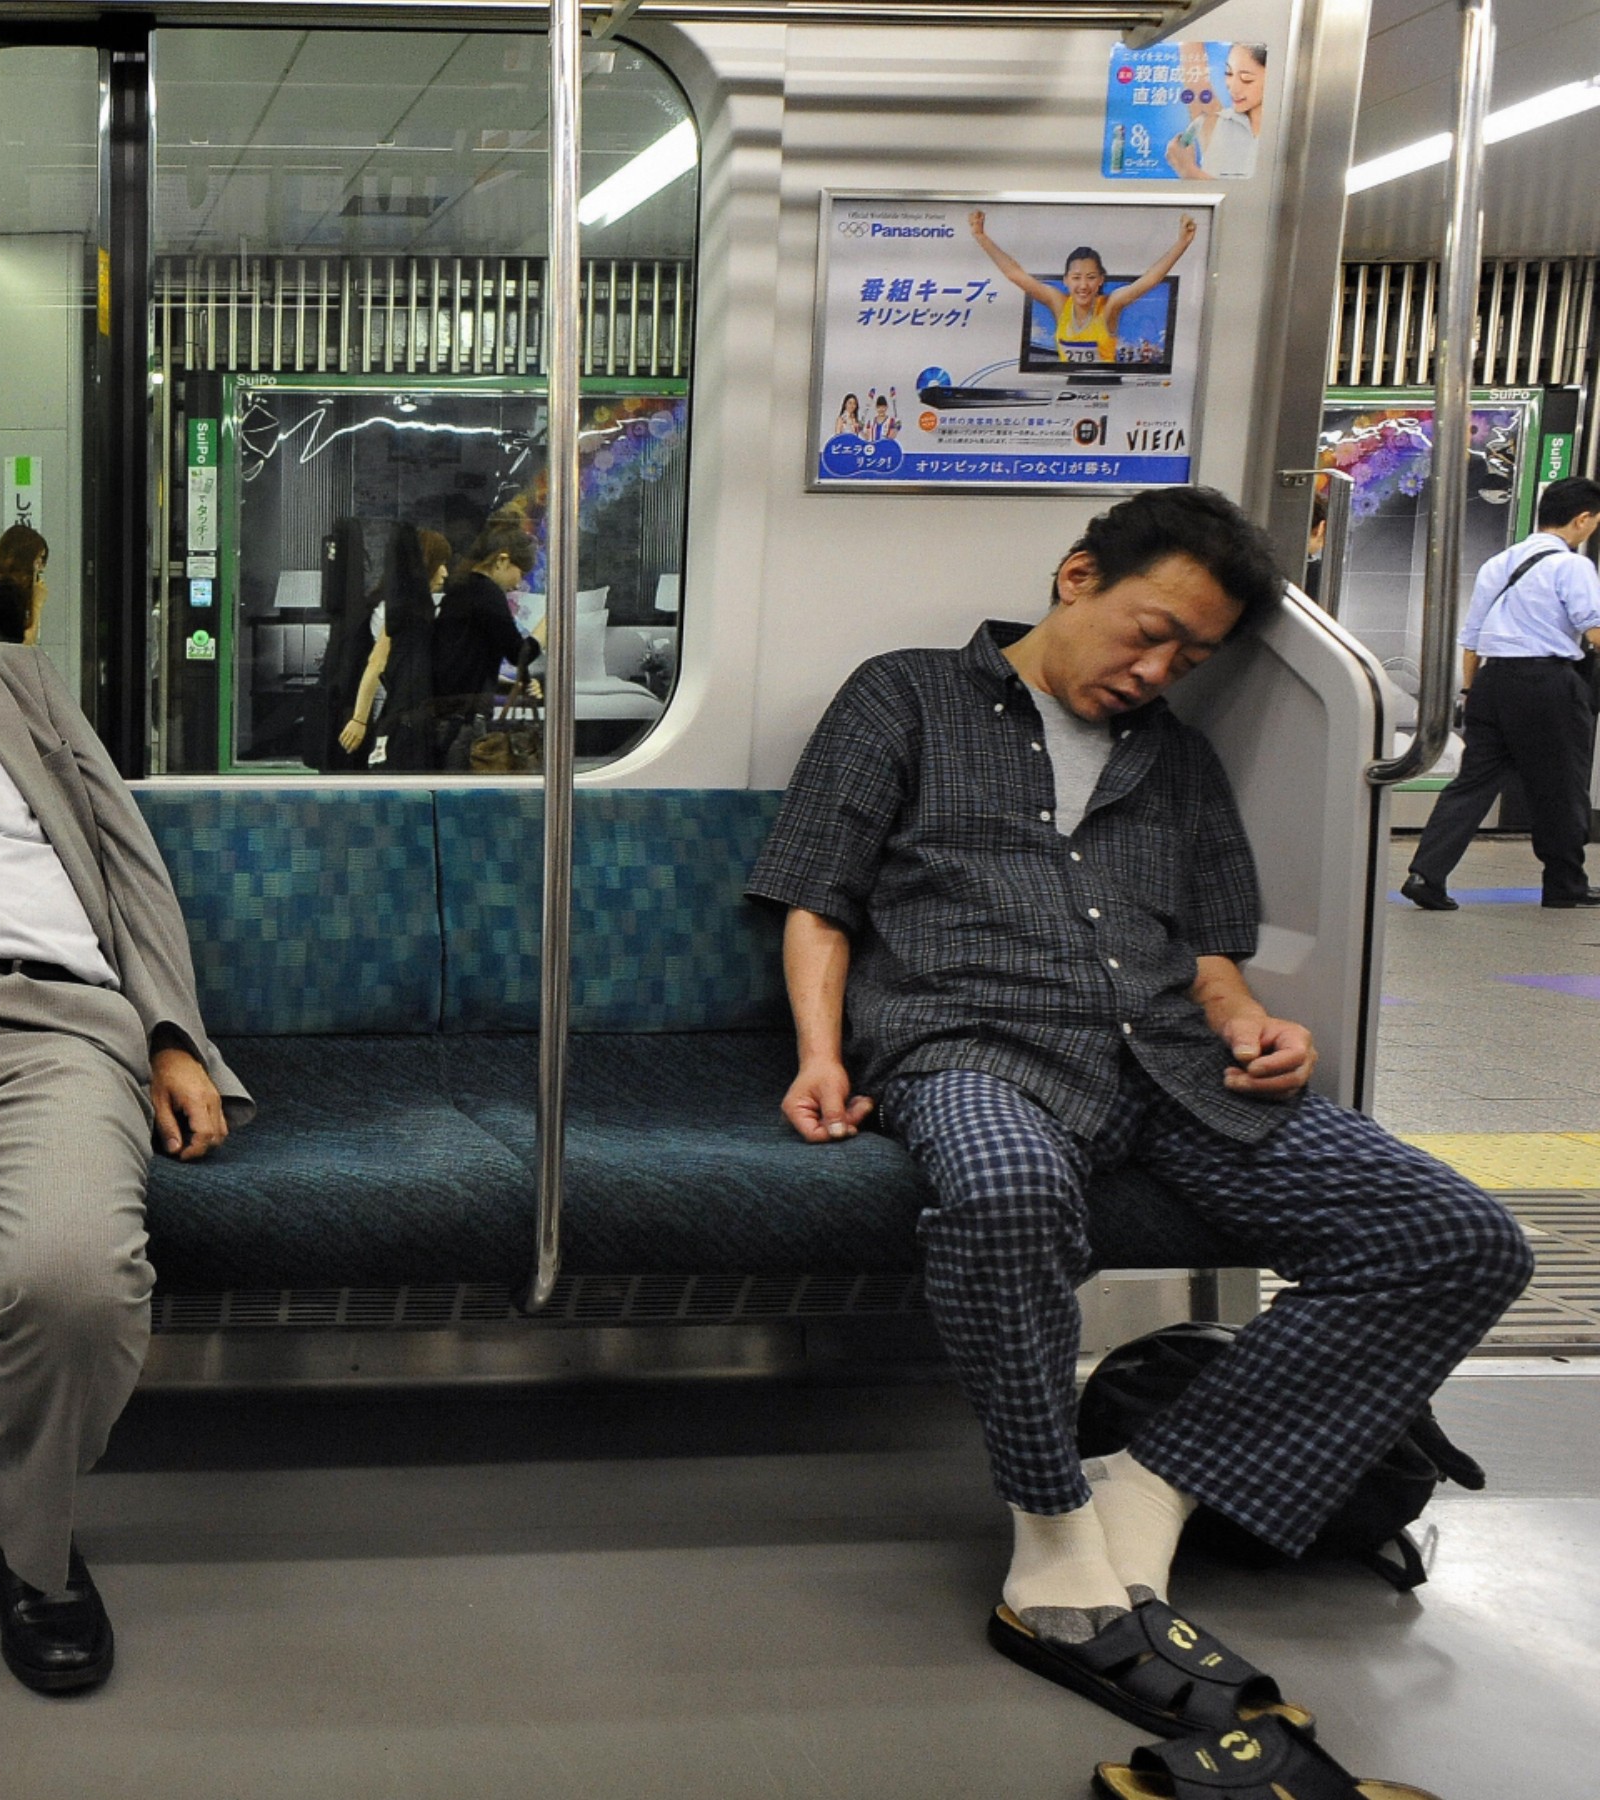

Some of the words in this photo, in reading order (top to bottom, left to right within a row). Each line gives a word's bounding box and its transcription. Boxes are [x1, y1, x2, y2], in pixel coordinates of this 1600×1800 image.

[871, 223, 955, 238] Panasonic
[859, 278, 998, 304] 番組キープで
[236, 374, 278, 386] SuiPo
[1489, 389, 1531, 400] SuiPo
[196, 422, 209, 465] SuiPo
[1548, 437, 1565, 479] SuiPo
[15, 493, 32, 528] しぶ
